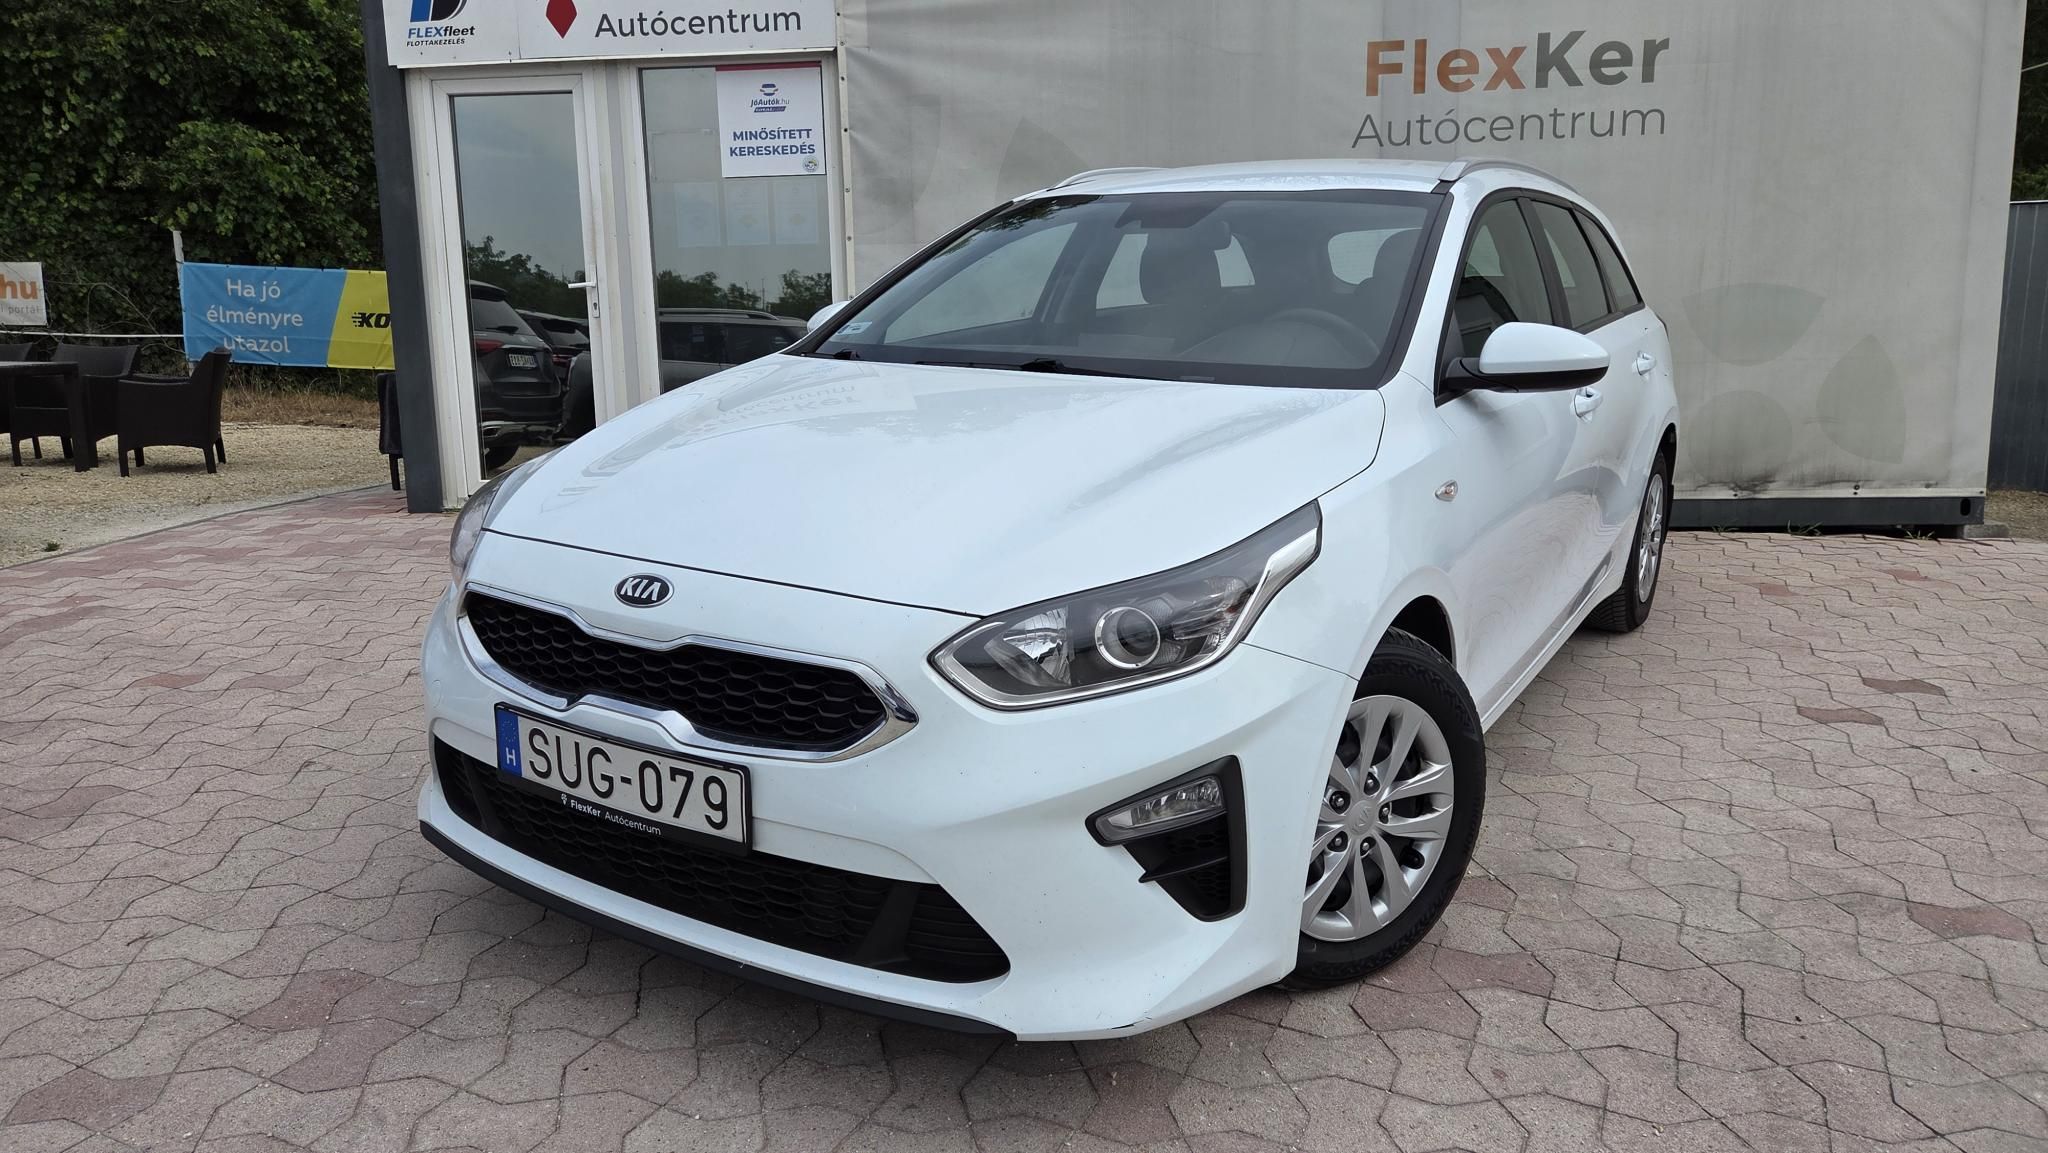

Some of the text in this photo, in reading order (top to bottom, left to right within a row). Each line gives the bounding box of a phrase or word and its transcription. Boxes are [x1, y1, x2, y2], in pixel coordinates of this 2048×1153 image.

[408, 25, 476, 39] FLEXfleet
[594, 9, 802, 38] Autócentrum
[406, 38, 466, 47] FLOTTAKEZELÉS
[1365, 30, 1671, 97] FlexKer
[1351, 107, 1666, 149] Autócentrum
[729, 142, 816, 157] KERESKEDÉS
[226, 278, 281, 302] Ha jó
[206, 304, 304, 330] élményre
[223, 335, 291, 353] utazol
[620, 577, 662, 601] KIA
[505, 747, 517, 766] H
[528, 728, 728, 831] SUG-079
[570, 799, 661, 836] FlexKer Autócentrum
